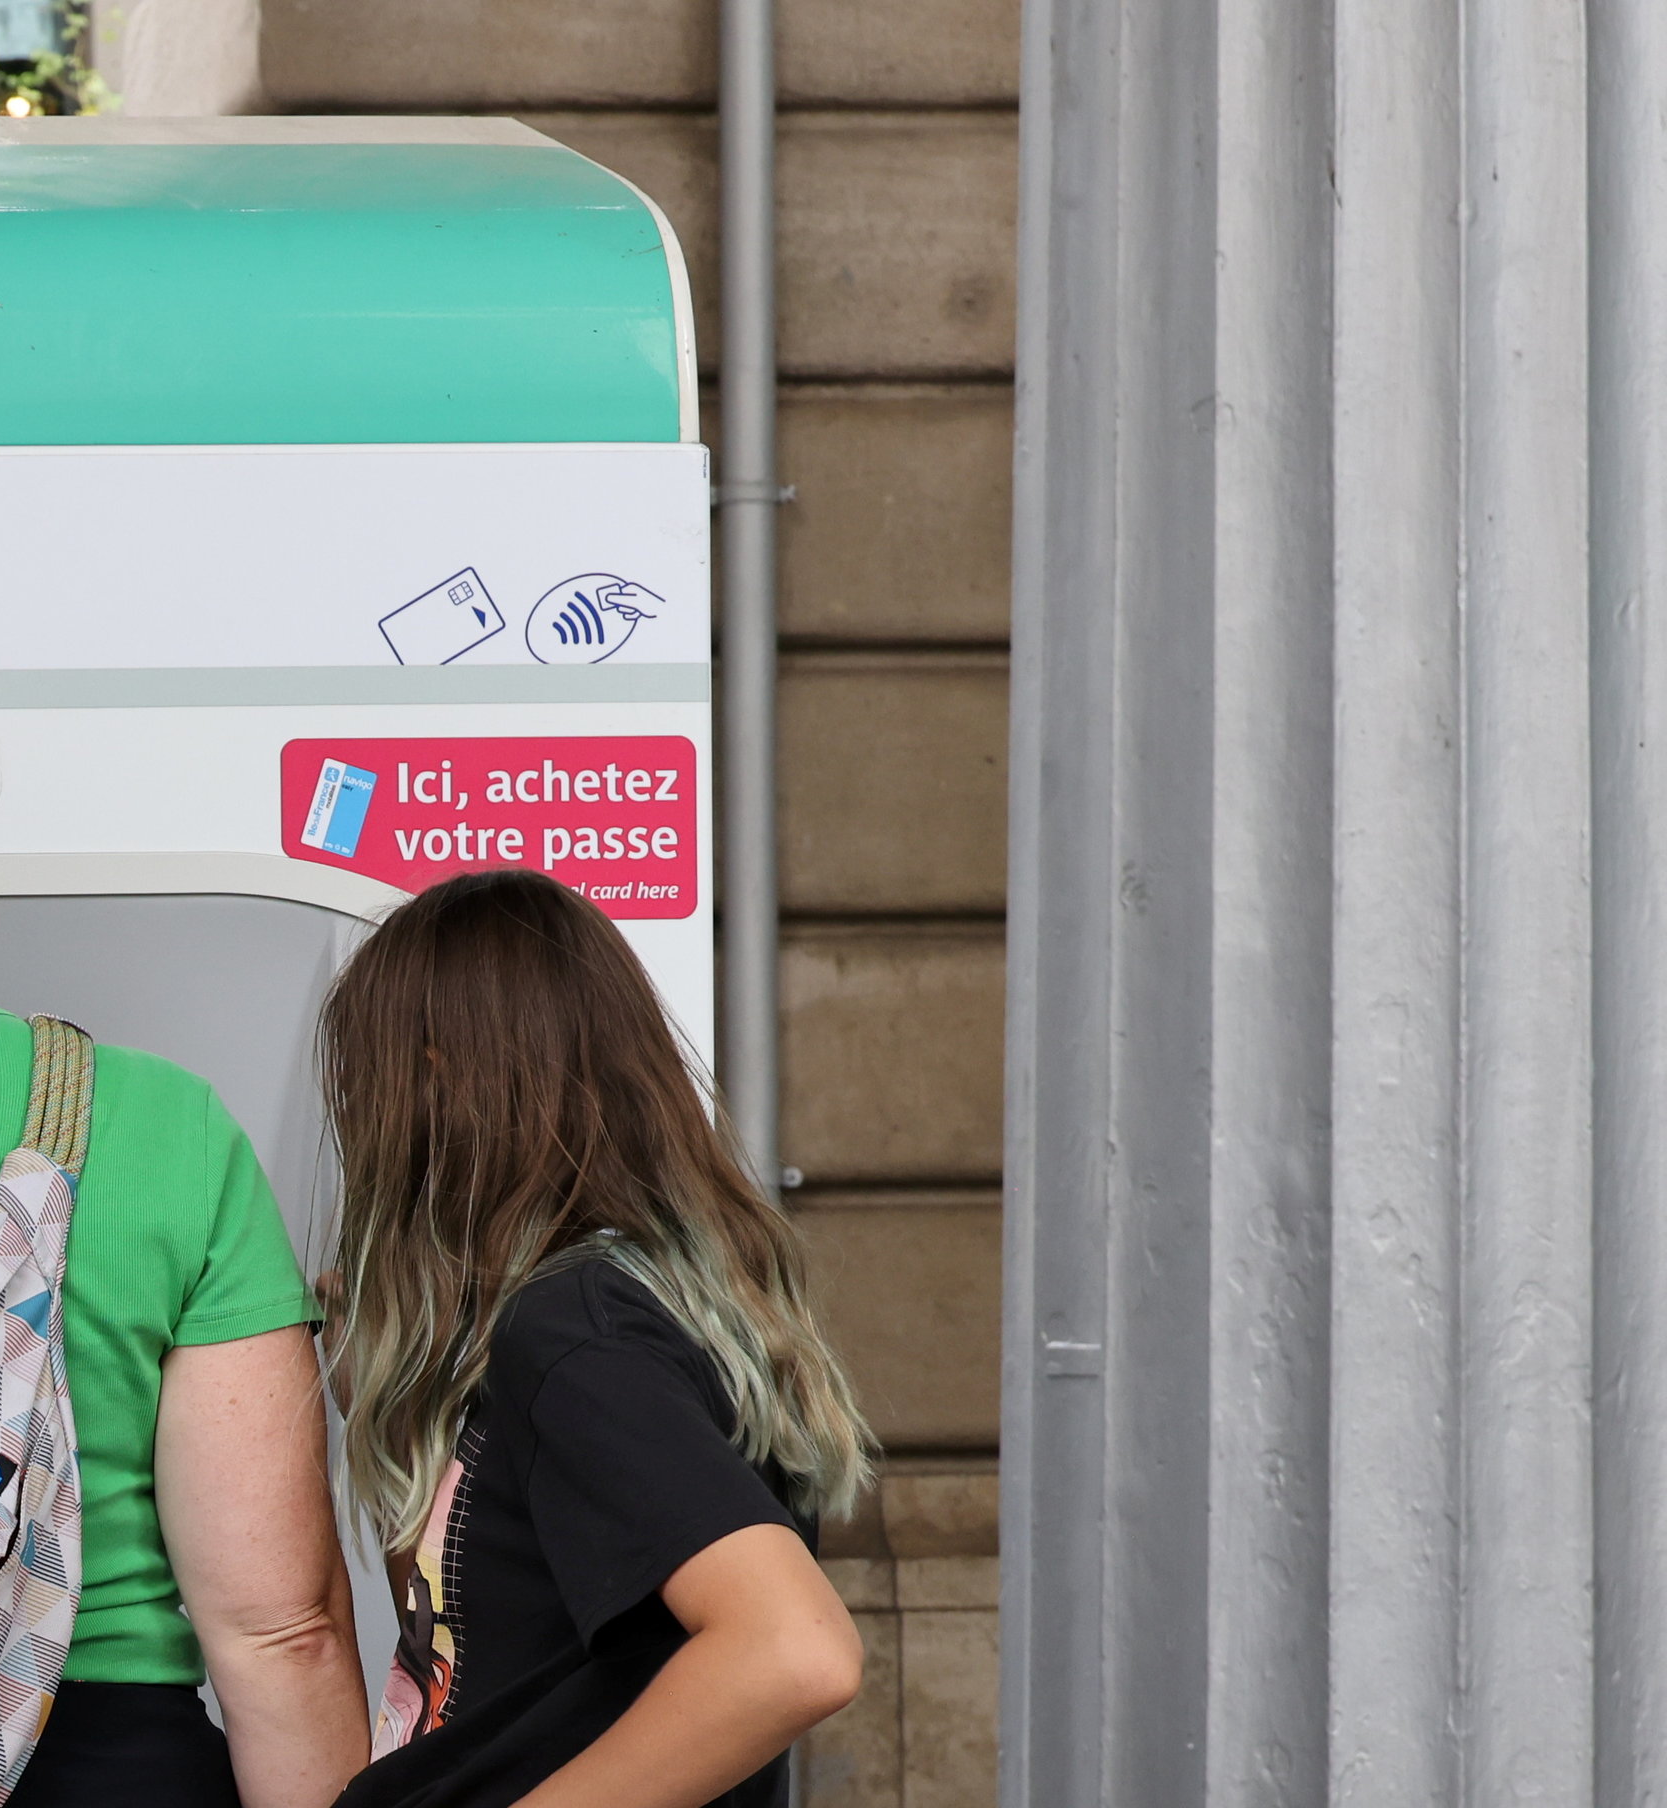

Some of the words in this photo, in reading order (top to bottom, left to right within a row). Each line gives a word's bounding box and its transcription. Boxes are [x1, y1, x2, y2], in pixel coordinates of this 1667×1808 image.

[397, 760, 468, 811] Ici,
[485, 759, 679, 803] achetez
[394, 820, 525, 861] votre
[542, 826, 679, 870] passe
[590, 881, 633, 899] card
[636, 881, 679, 899] here
